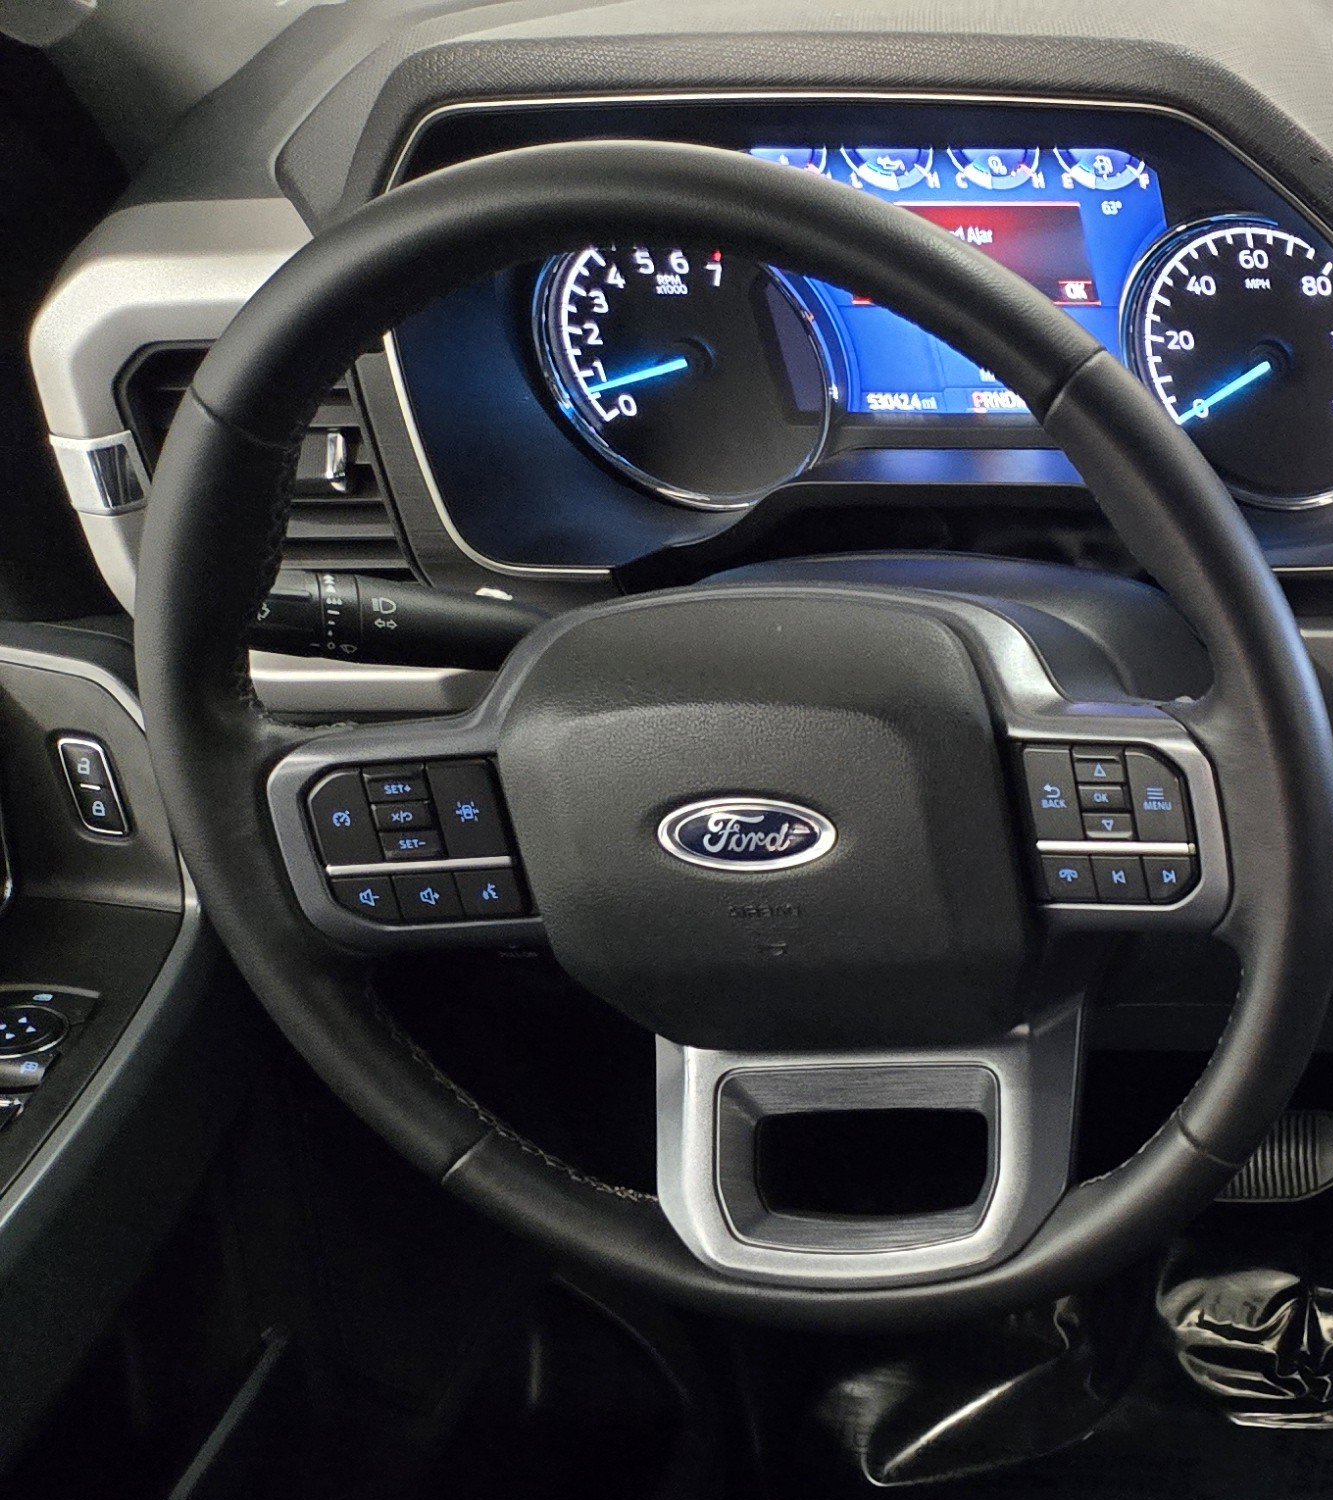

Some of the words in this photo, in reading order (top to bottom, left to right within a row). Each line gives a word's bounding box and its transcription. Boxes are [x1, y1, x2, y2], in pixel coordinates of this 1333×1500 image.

[634, 249, 655, 275] 5
[669, 249, 690, 274] 6
[1238, 249, 1270, 270] 60
[606, 263, 627, 289] 4
[656, 274, 682, 286] RPM
[705, 262, 723, 287] 7
[1244, 278, 1271, 290] MPH
[1064, 282, 1088, 300] OK
[1186, 275, 1216, 297] 40
[1301, 275, 1332, 297] 80
[588, 290, 609, 314] 3
[582, 321, 604, 345] 2
[1165, 329, 1195, 351] 20
[592, 359, 608, 383] 1
[617, 394, 638, 417] 0
[1041, 799, 1068, 809] BACK
[1093, 792, 1109, 803] OK
[1142, 801, 1173, 811] MENU
[702, 811, 793, 853] Ford
